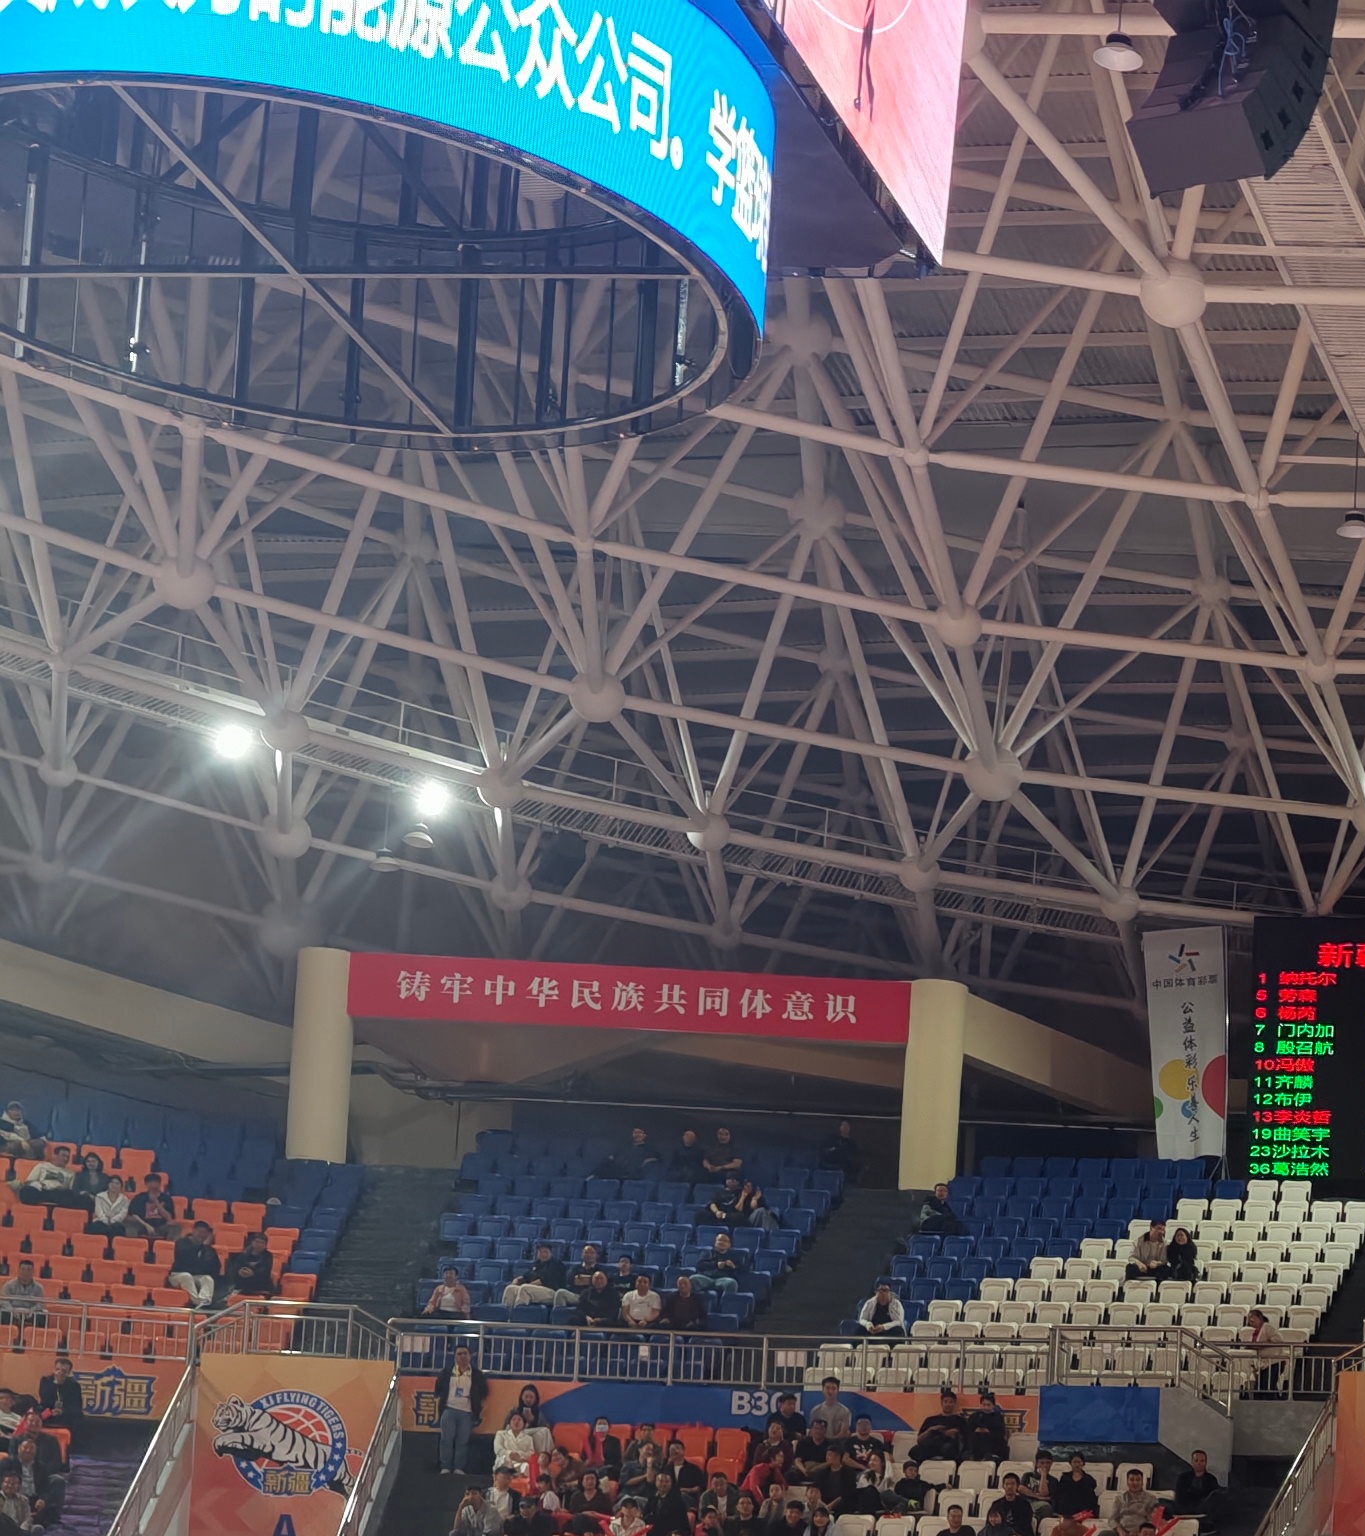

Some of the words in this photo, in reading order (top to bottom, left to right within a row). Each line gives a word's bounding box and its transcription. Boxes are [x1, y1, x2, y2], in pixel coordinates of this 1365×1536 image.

[1152, 975, 1218, 990] 中国体育彩票
[1258, 973, 1266, 984] 1
[395, 970, 858, 1025] 铸牢中华民族共同体意识
[1256, 990, 1267, 1001] 5
[1255, 1007, 1267, 1019] 6
[1255, 1025, 1265, 1035] 7
[1278, 1023, 1334, 1038] 门内加
[1254, 1042, 1264, 1053] 8
[1276, 1041, 1334, 1055] 殷召航
[276, 1391, 318, 1408] FLYING
[317, 1401, 345, 1440] TIGERS
[264, 1468, 311, 1496] 新疆
